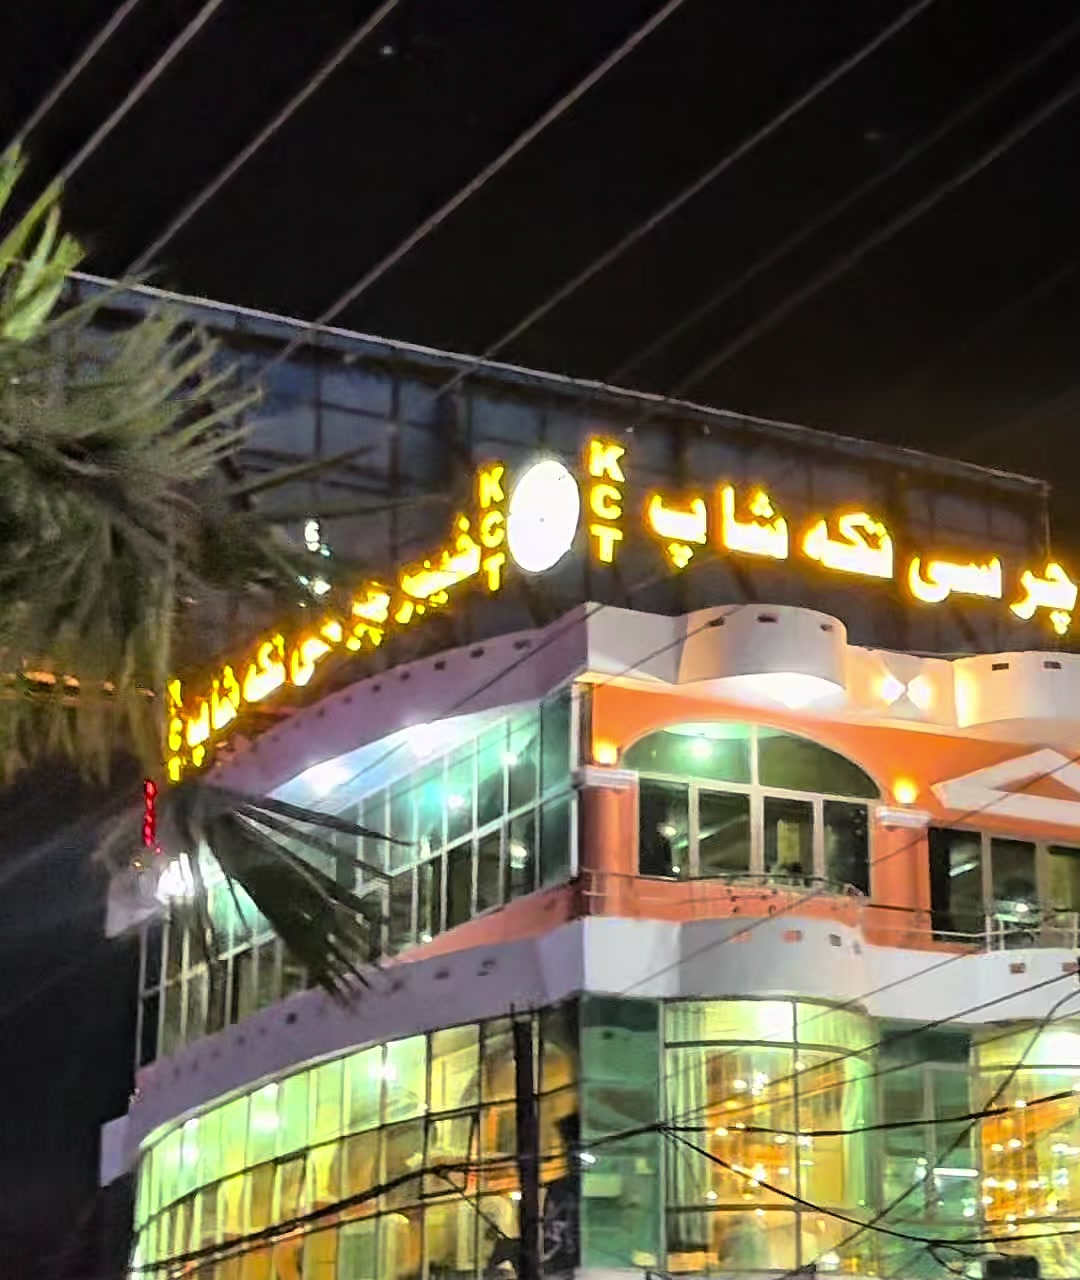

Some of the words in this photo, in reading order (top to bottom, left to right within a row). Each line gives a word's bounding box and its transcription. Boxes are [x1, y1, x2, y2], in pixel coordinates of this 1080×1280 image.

[478, 465, 505, 591] KCT
[590, 438, 626, 564] KCT
[648, 484, 789, 569] شاپ
